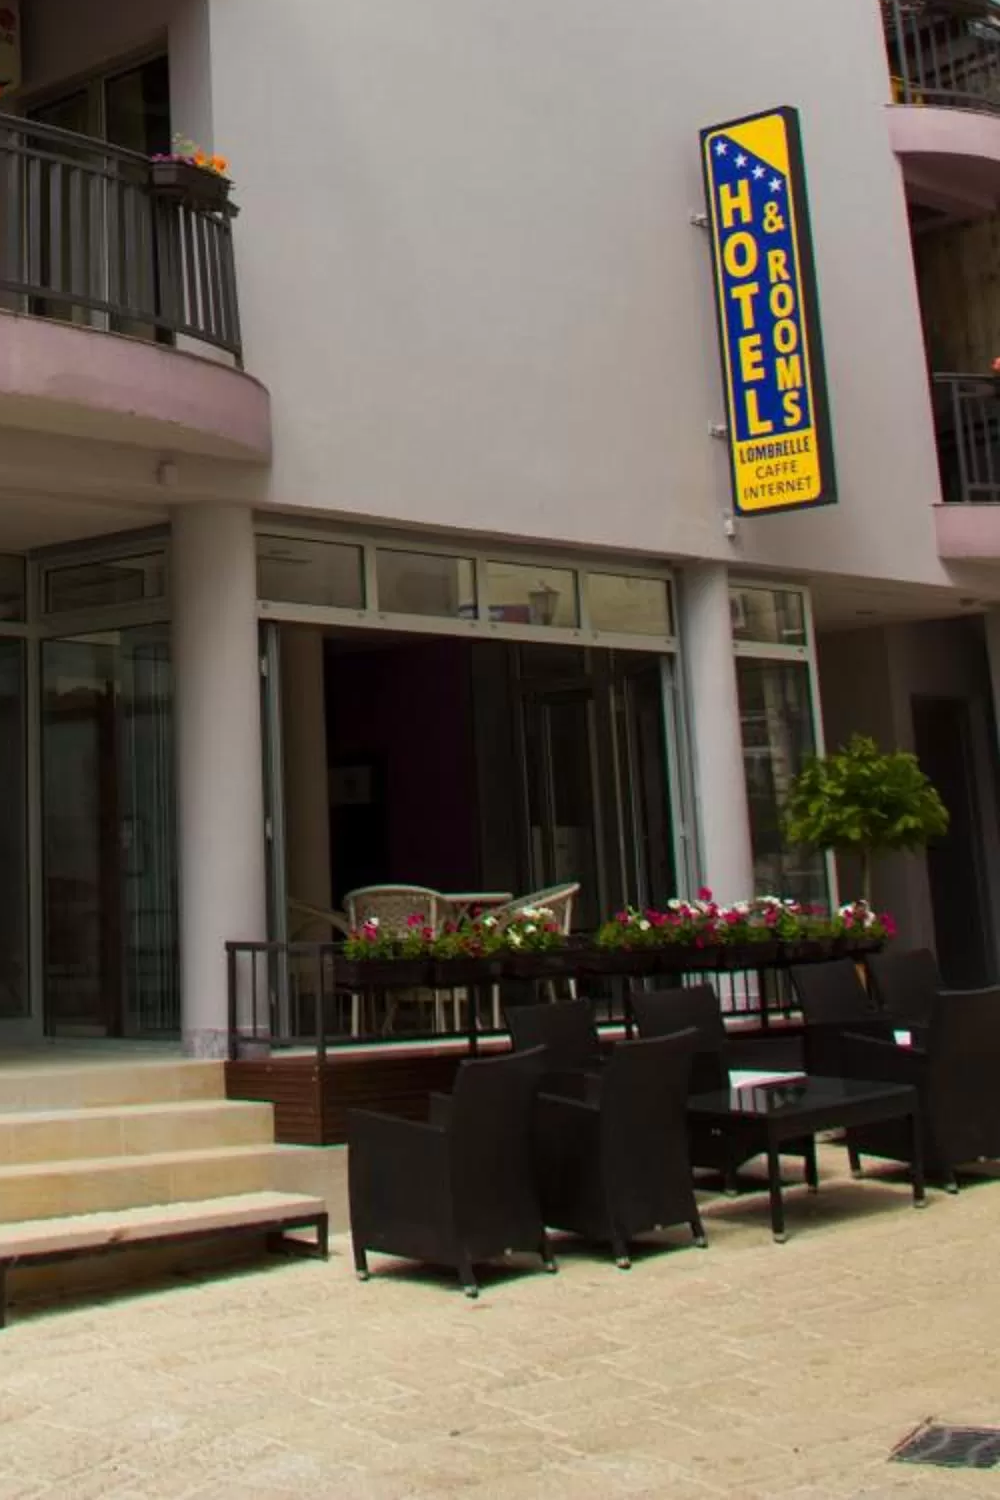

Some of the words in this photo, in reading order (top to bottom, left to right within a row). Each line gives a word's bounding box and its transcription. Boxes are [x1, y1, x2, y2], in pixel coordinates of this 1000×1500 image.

[763, 201, 785, 233] &
[719, 178, 773, 436] HOTEL
[767, 248, 803, 427] ROOMS
[738, 435, 811, 465] LOMBRELLE
[755, 460, 799, 480] CAFFE
[743, 475, 812, 500] INTERNET
